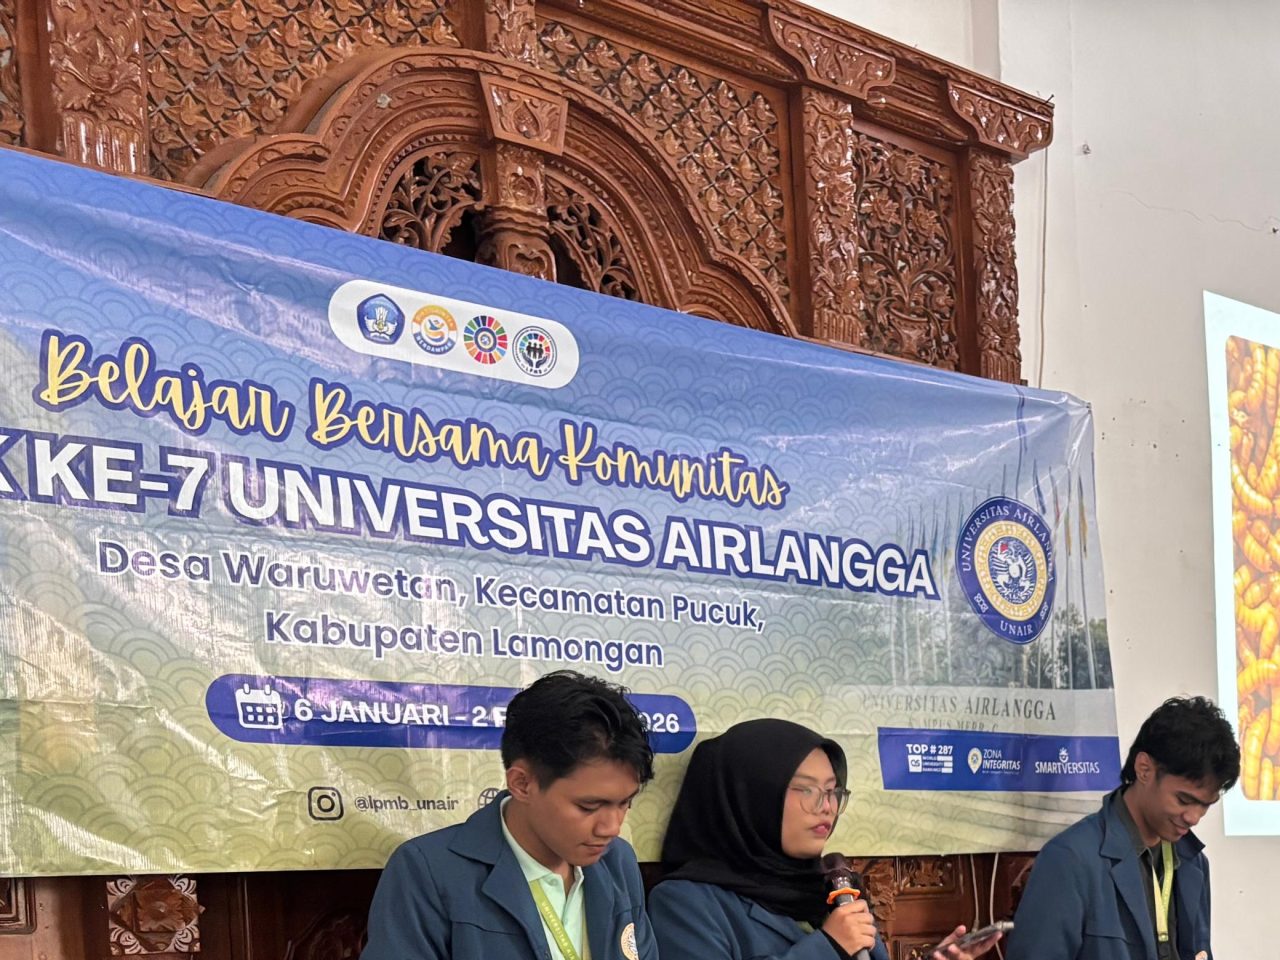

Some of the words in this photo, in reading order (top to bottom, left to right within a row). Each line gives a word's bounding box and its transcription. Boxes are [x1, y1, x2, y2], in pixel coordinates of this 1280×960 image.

[39, 335, 289, 436] Belajar
[312, 383, 550, 477] Bersama
[559, 424, 788, 506] Komunitas
[34, 438, 208, 512] KE-7
[229, 461, 652, 562] UNIVERSITAS
[662, 521, 937, 596] AIRLANGGA
[961, 505, 1010, 573] UNIVERSITAS
[99, 541, 211, 581] Desa
[222, 551, 467, 608] Waruwetan,
[475, 576, 665, 620] Kecamatan
[672, 595, 765, 632] Pucuk,
[1000, 620, 1034, 637] UNAIR
[265, 611, 483, 658] Kabupaten
[492, 628, 664, 672] Lamongan
[294, 698, 313, 722] 6
[321, 700, 449, 726] JANUARI
[472, 706, 488, 727] 2
[638, 711, 680, 734] 026
[965, 696, 1056, 721] AIRLANGGA
[906, 743, 928, 754] TOP
[930, 745, 937, 755] #
[938, 745, 954, 755] 287
[983, 749, 1002, 759] ZONA
[982, 759, 1021, 770] INTEGRITAS
[1034, 761, 1100, 775] SMARTVERSITAS
[354, 795, 460, 814] @lpmb_unair
